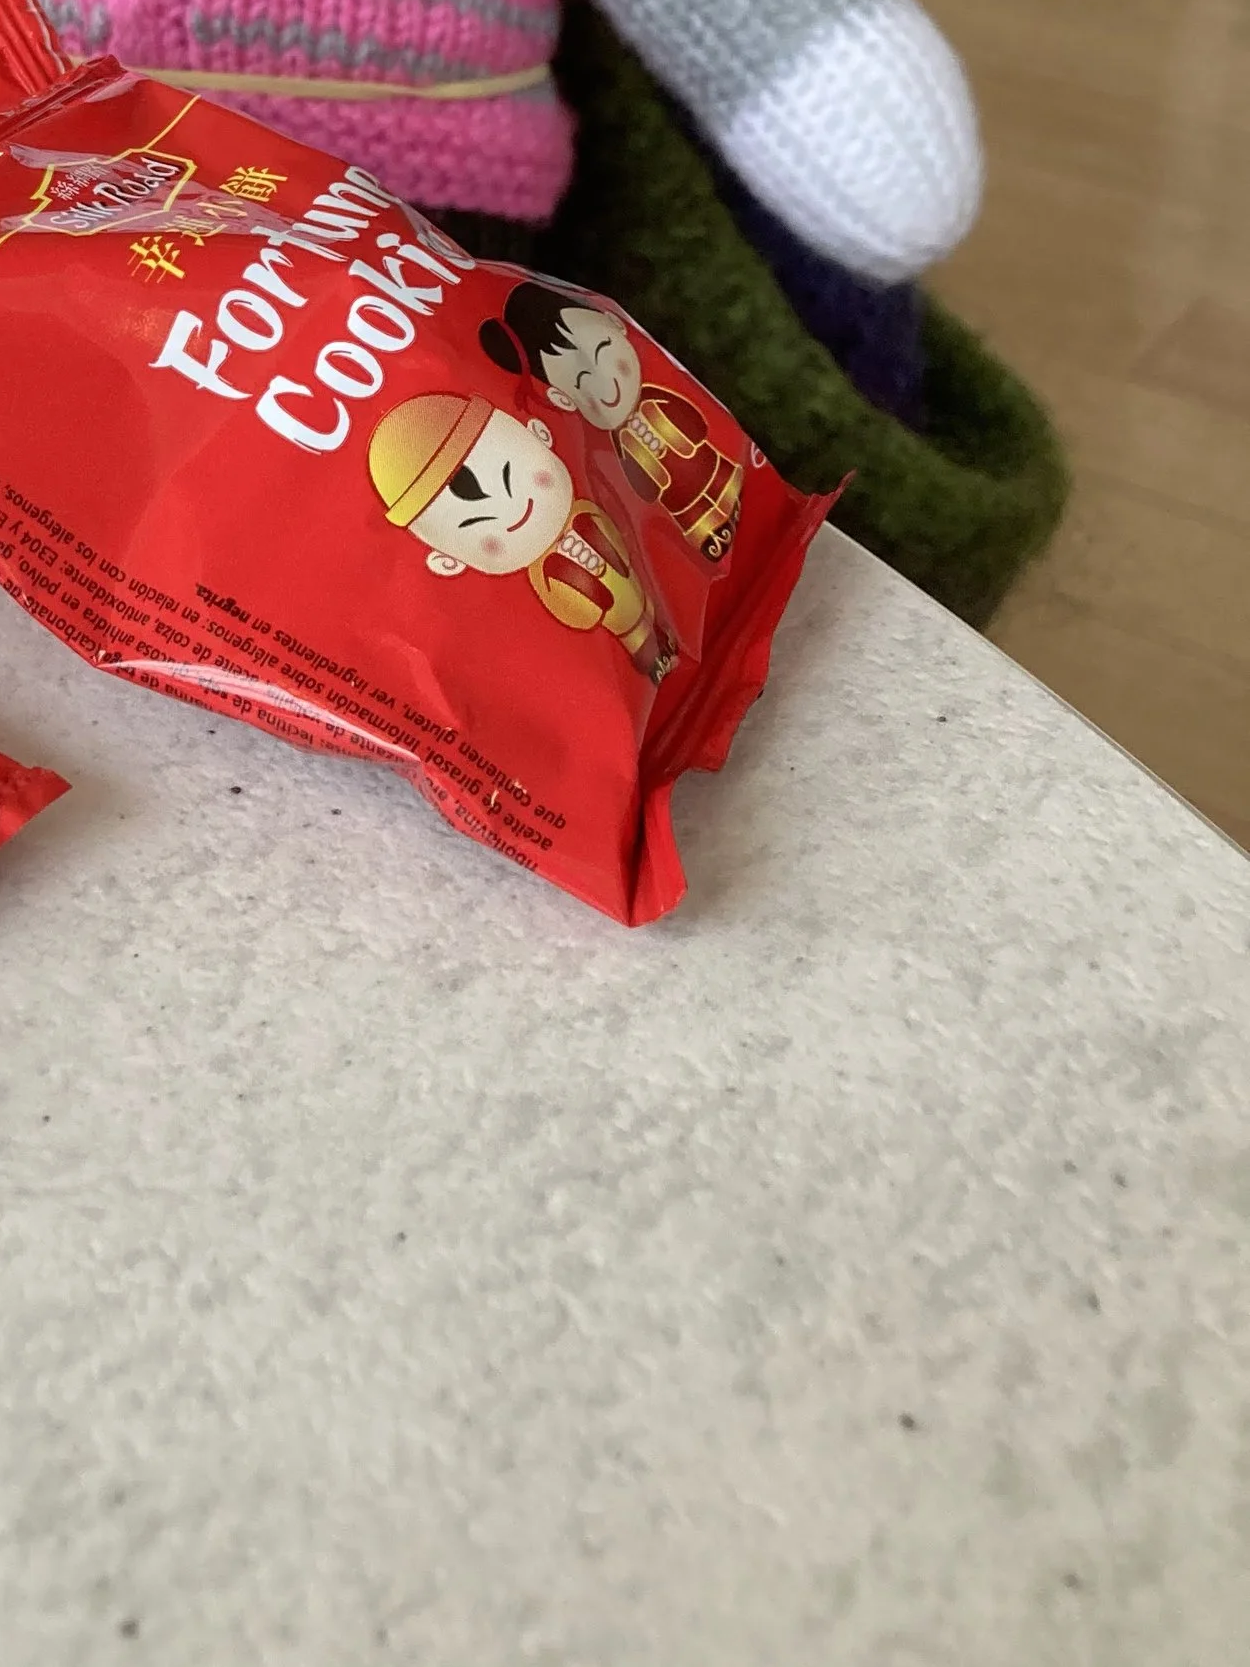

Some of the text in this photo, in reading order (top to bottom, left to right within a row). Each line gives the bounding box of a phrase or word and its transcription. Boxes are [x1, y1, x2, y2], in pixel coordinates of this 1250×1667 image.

[49, 155, 182, 231] Silk Road
[6, 516, 25, 537] y
[17, 529, 59, 568] E304
[70, 540, 99, 566] los
[11, 553, 62, 598] polvo,
[97, 557, 128, 584] con
[56, 559, 151, 629] antioxidante:
[58, 590, 79, 610] en
[126, 577, 181, 614] relación
[79, 605, 136, 649] anhidra
[179, 606, 201, 624] en
[148, 617, 191, 652] colza,
[188, 641, 213, 665] de
[200, 616, 280, 672] alérgenos:
[137, 671, 161, 690] de
[277, 662, 326, 697] sobre
[189, 583, 569, 830] que contienen gluten, ver ingredientes en negrita.
[227, 693, 253, 714] de
[323, 688, 421, 754] Información
[253, 708, 316, 745] lecitina
[419, 745, 484, 798] girasol.
[477, 792, 504, 818] de
[499, 812, 554, 854] aceite
